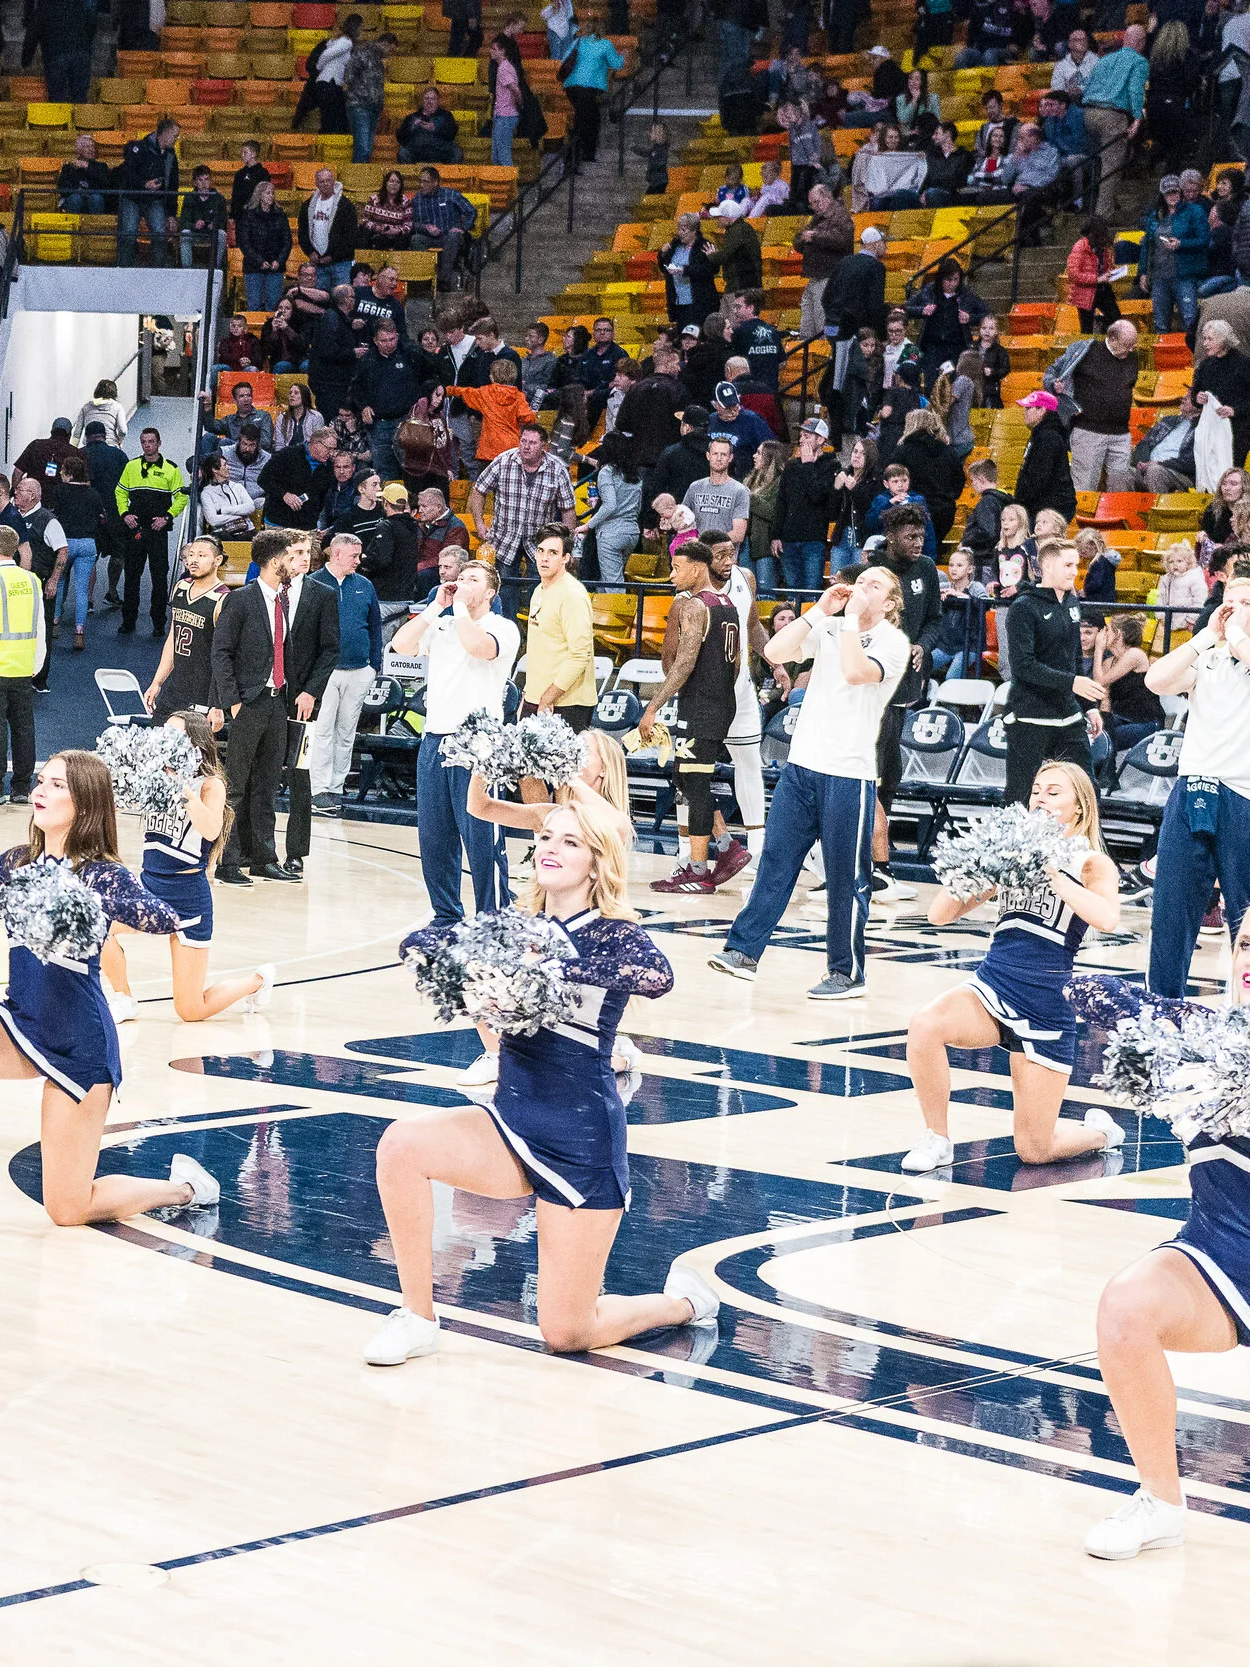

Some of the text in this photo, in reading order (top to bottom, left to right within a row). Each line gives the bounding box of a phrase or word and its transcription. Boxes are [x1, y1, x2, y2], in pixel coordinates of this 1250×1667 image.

[356, 301, 393, 319] AGGIES
[748, 345, 778, 355] AGGIES
[710, 494, 733, 508] STATE
[8, 588, 33, 597] SERVICES
[174, 624, 193, 657] 12
[390, 660, 422, 670] GATORADE
